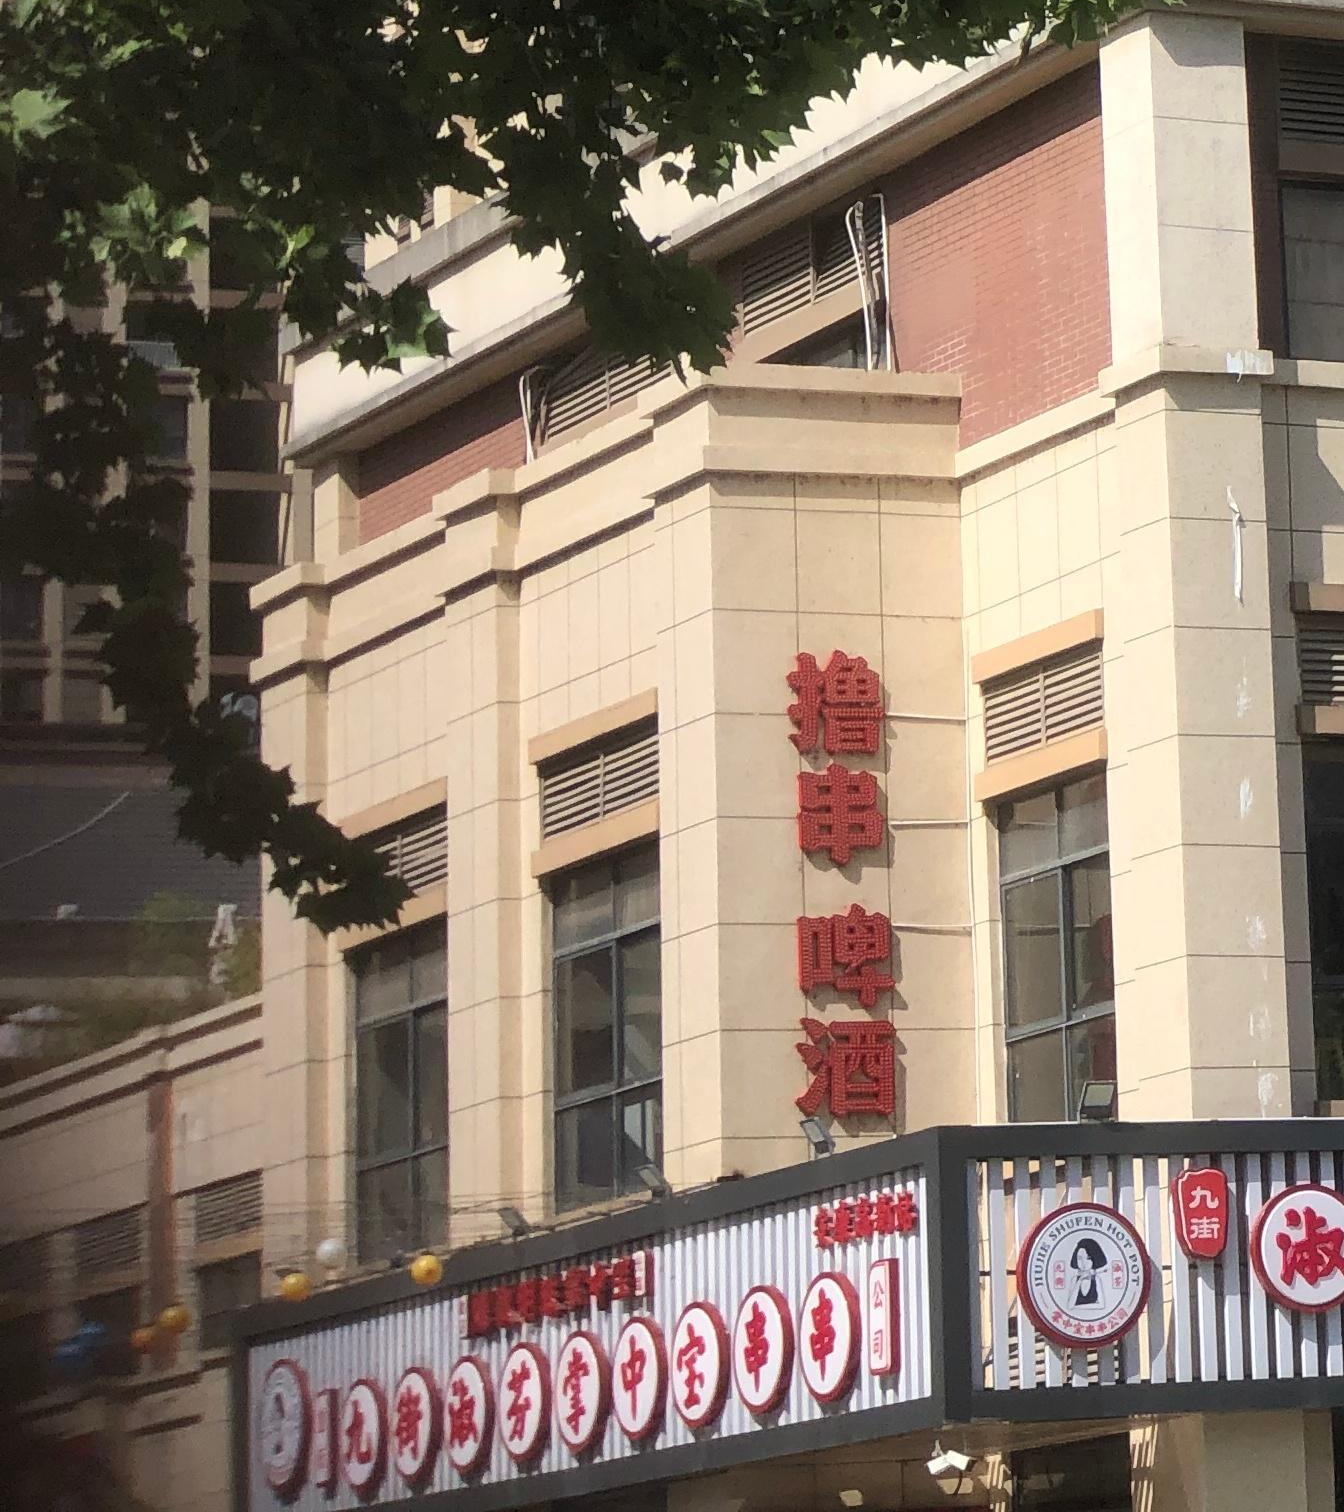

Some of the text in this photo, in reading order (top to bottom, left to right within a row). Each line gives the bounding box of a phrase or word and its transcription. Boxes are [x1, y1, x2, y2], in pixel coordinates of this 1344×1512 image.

[1189, 1185, 1220, 1239] 九街
[1049, 1216, 1104, 1242] SHUFEN
[1107, 1223, 1132, 1249] HOT
[1128, 1253, 1140, 1287] POT
[872, 1281, 887, 1361] 公司
[345, 1288, 836, 1465] 九街淑芬掌中宝串串
